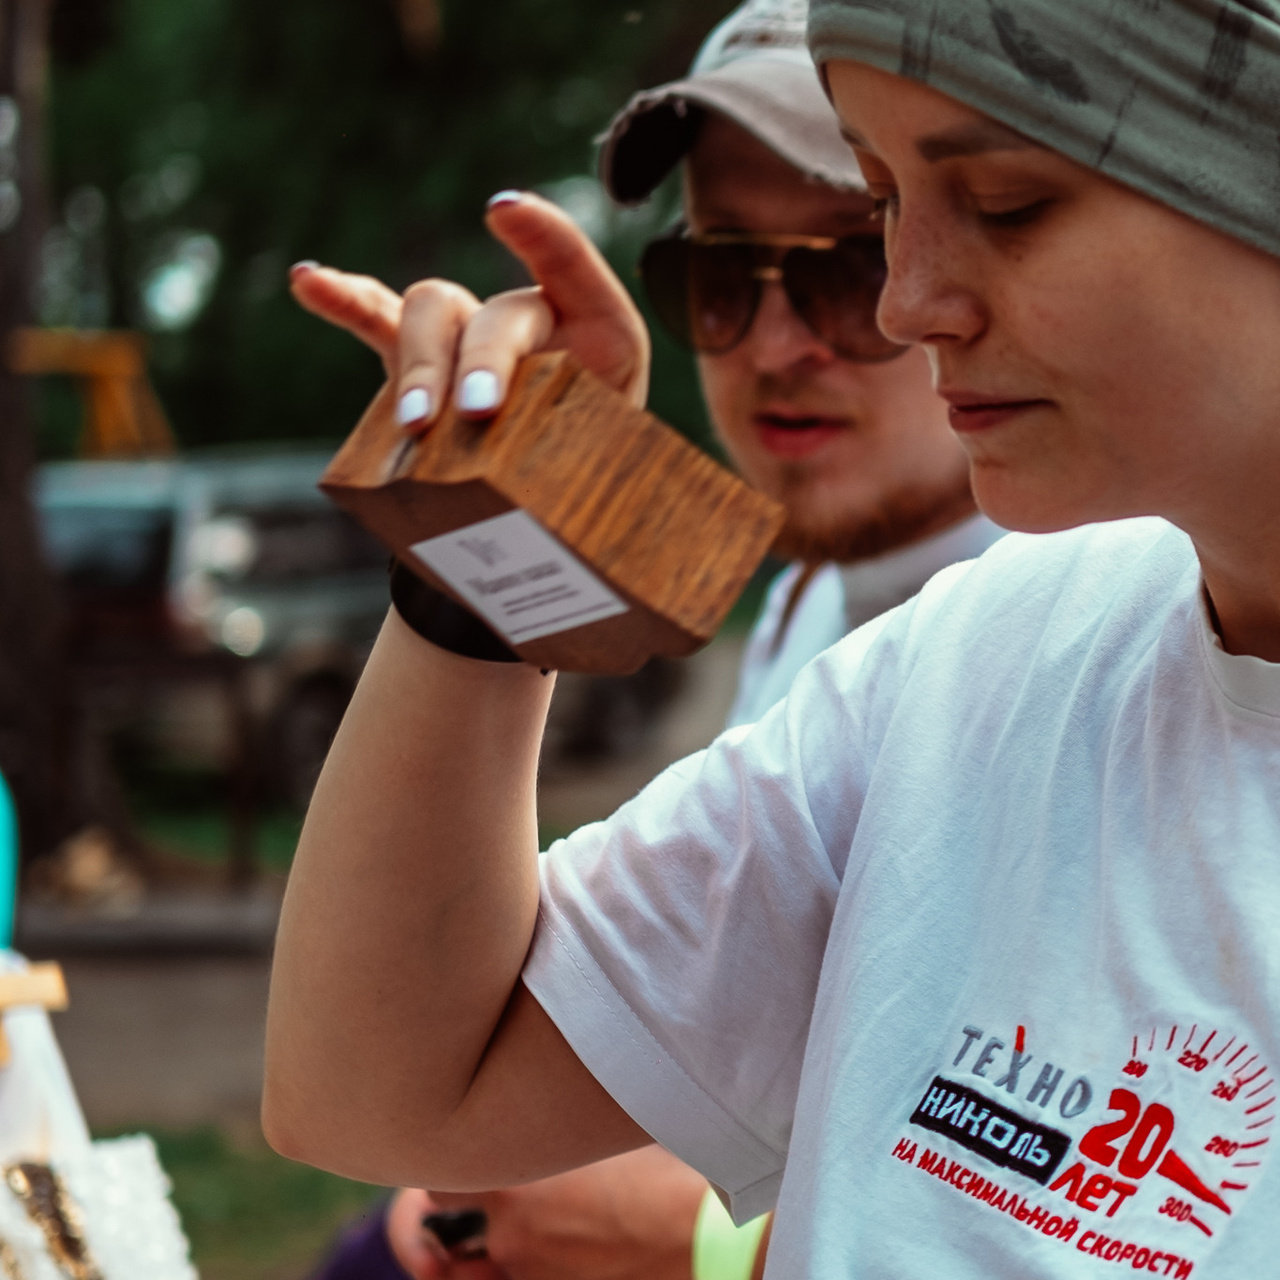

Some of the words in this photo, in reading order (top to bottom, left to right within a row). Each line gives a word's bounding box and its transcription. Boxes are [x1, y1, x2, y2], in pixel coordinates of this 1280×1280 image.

[952, 1024, 1093, 1119] ТЕХНО
[1177, 1049, 1209, 1072] 220
[920, 1086, 1051, 1167] НИКОЛЬ
[1078, 1087, 1175, 1180] 20
[891, 1137, 918, 1164] НА
[916, 1148, 1080, 1243] МАКСИМАЛЬНОЙ
[1158, 1196, 1192, 1222] 300
